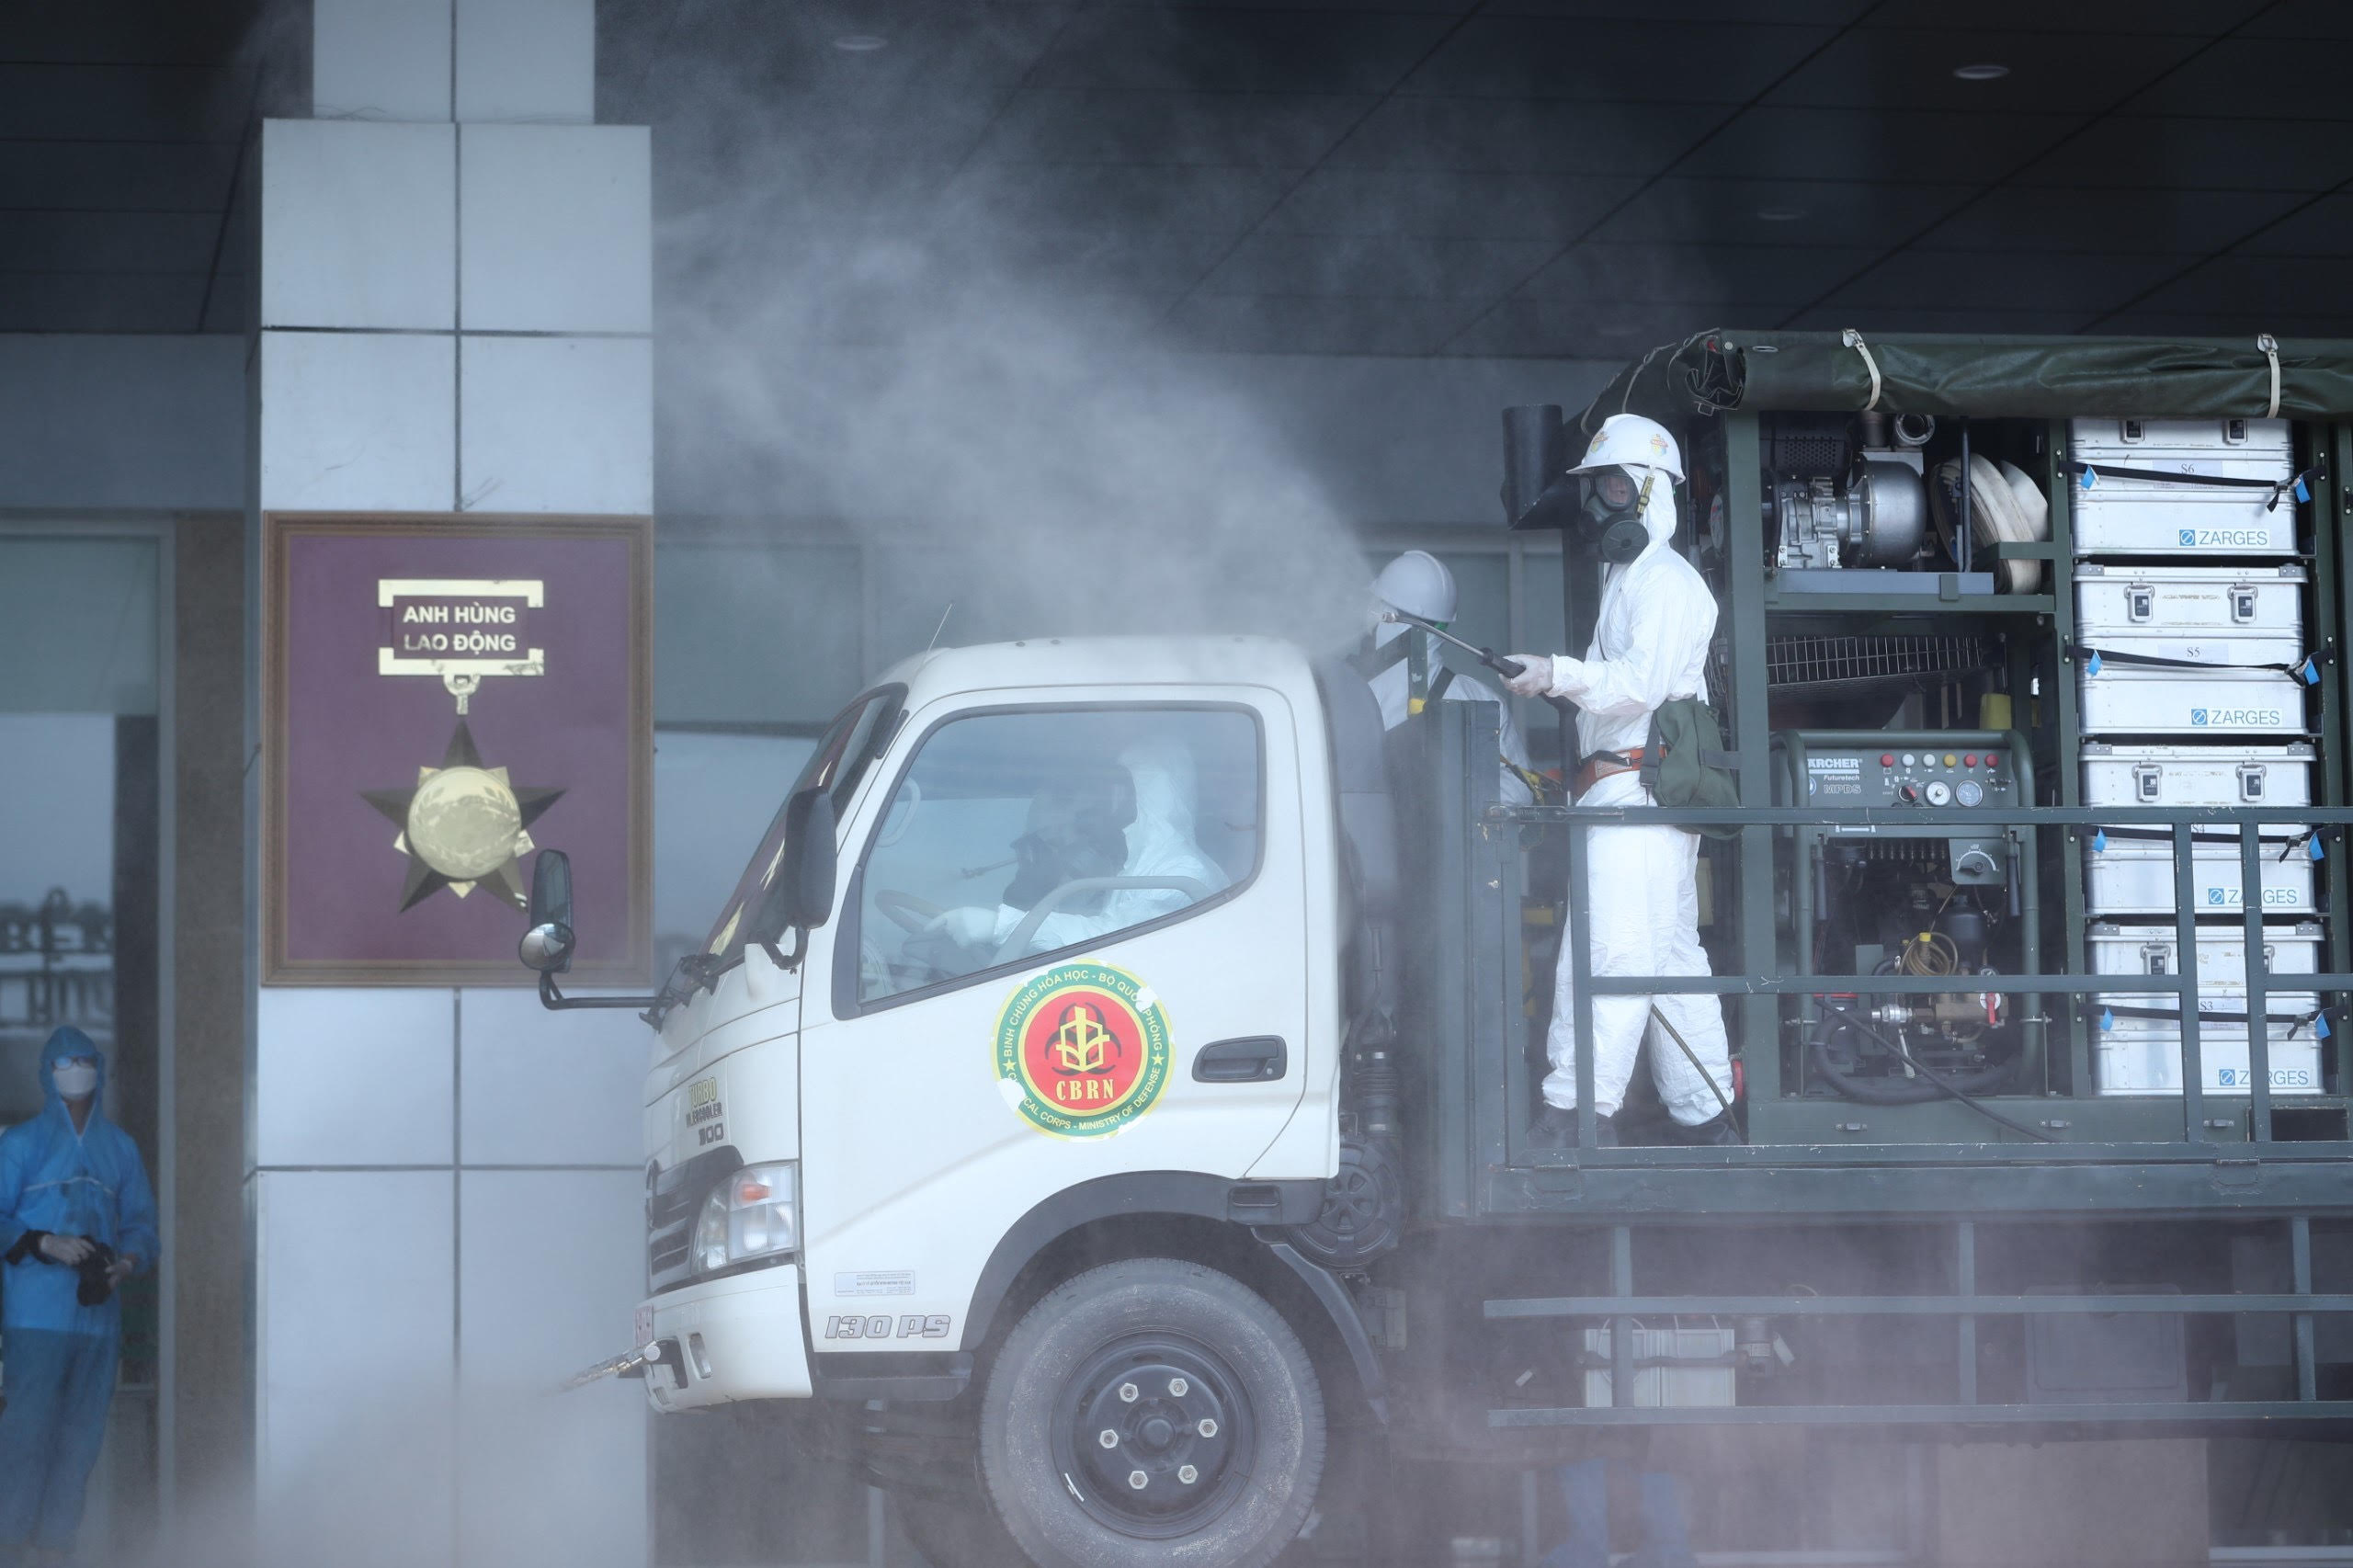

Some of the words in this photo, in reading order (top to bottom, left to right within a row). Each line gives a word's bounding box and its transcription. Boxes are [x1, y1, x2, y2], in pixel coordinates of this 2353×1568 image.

[2200, 530, 2268, 546] ZARGES
[403, 606, 449, 623] ANH
[454, 601, 517, 624] HÙNG
[404, 634, 449, 651] LAO
[453, 630, 517, 655] ĐỘNG
[2188, 646, 2200, 658] S5
[2211, 710, 2280, 725] ZARGES
[1004, 1028, 1016, 1058] BINH
[1063, 970, 1089, 982] HỌC
[1040, 1110, 1072, 1130] CORPS
[1078, 1110, 1121, 1131] MINISTRY
[1121, 1104, 1133, 1118] OF
[1133, 1067, 1161, 1108] DEFENSE
[1056, 1078, 1115, 1101] CBRN
[824, 1315, 893, 1339] 130
[896, 1314, 951, 1338] PS
